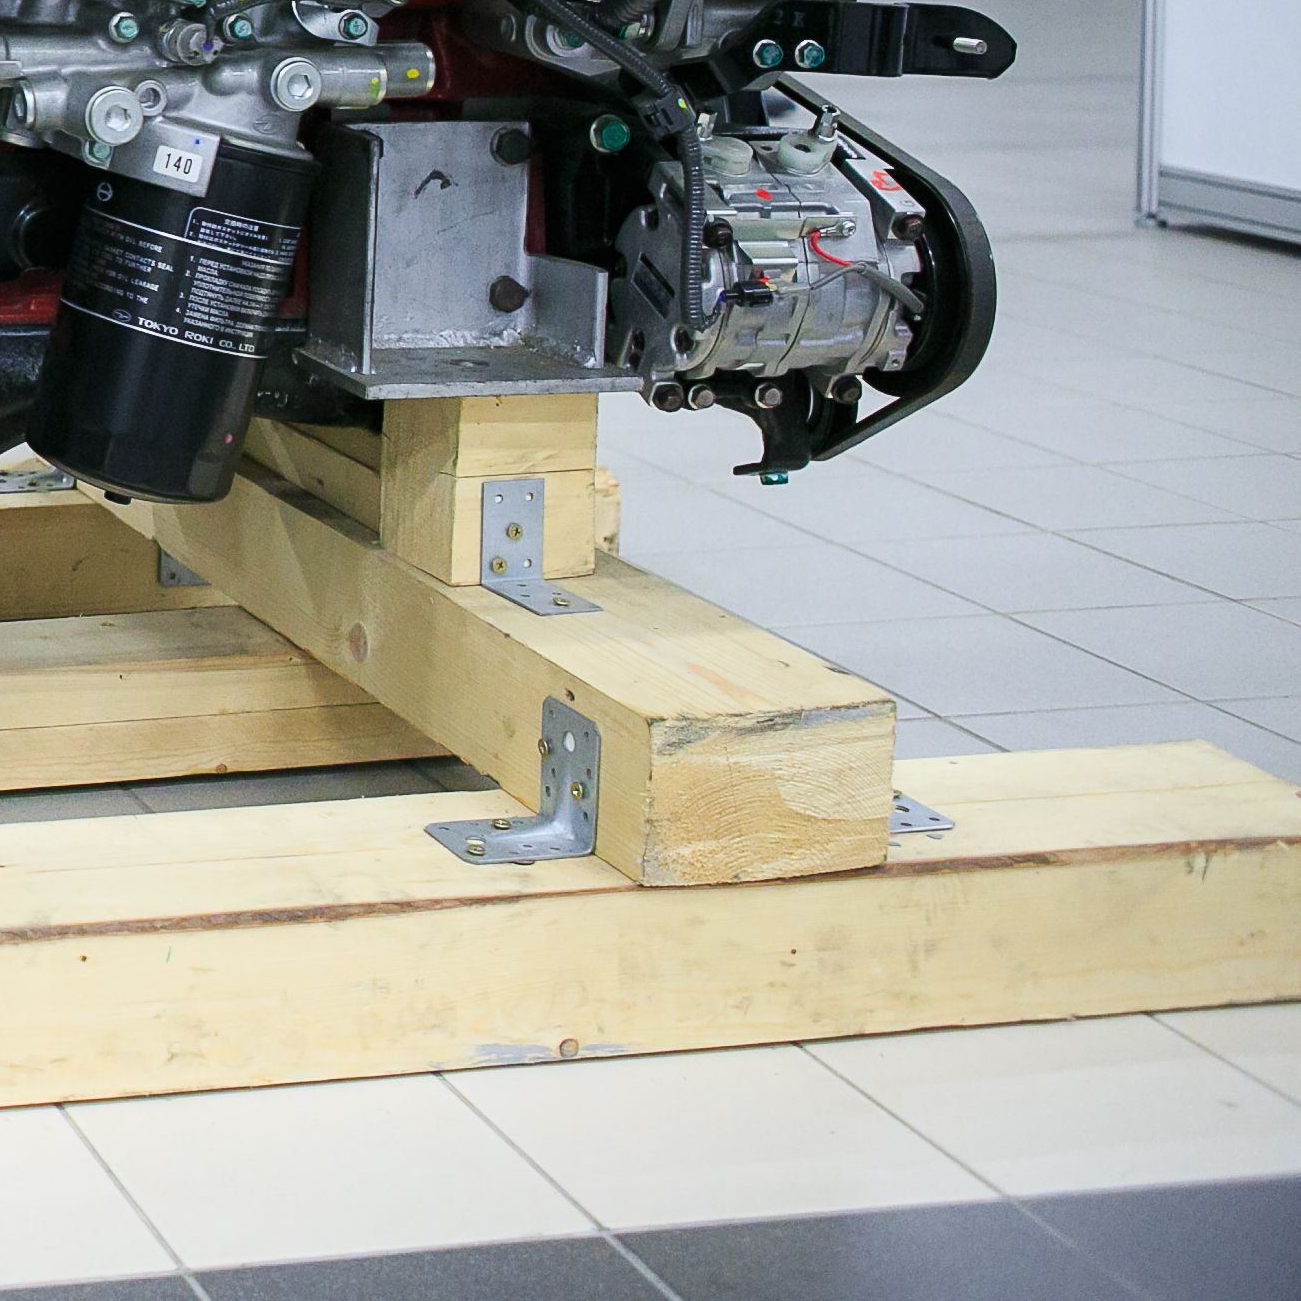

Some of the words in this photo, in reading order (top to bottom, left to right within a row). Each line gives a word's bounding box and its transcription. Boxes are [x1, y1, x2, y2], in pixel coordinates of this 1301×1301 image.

[164, 153, 193, 175] 140
[139, 240, 163, 253] BEFORE
[157, 261, 174, 272] SEAL
[131, 278, 159, 292] LEAKAGE
[136, 294, 149, 305] THE
[138, 317, 178, 335] TOKYO
[184, 331, 214, 345] ROKI
